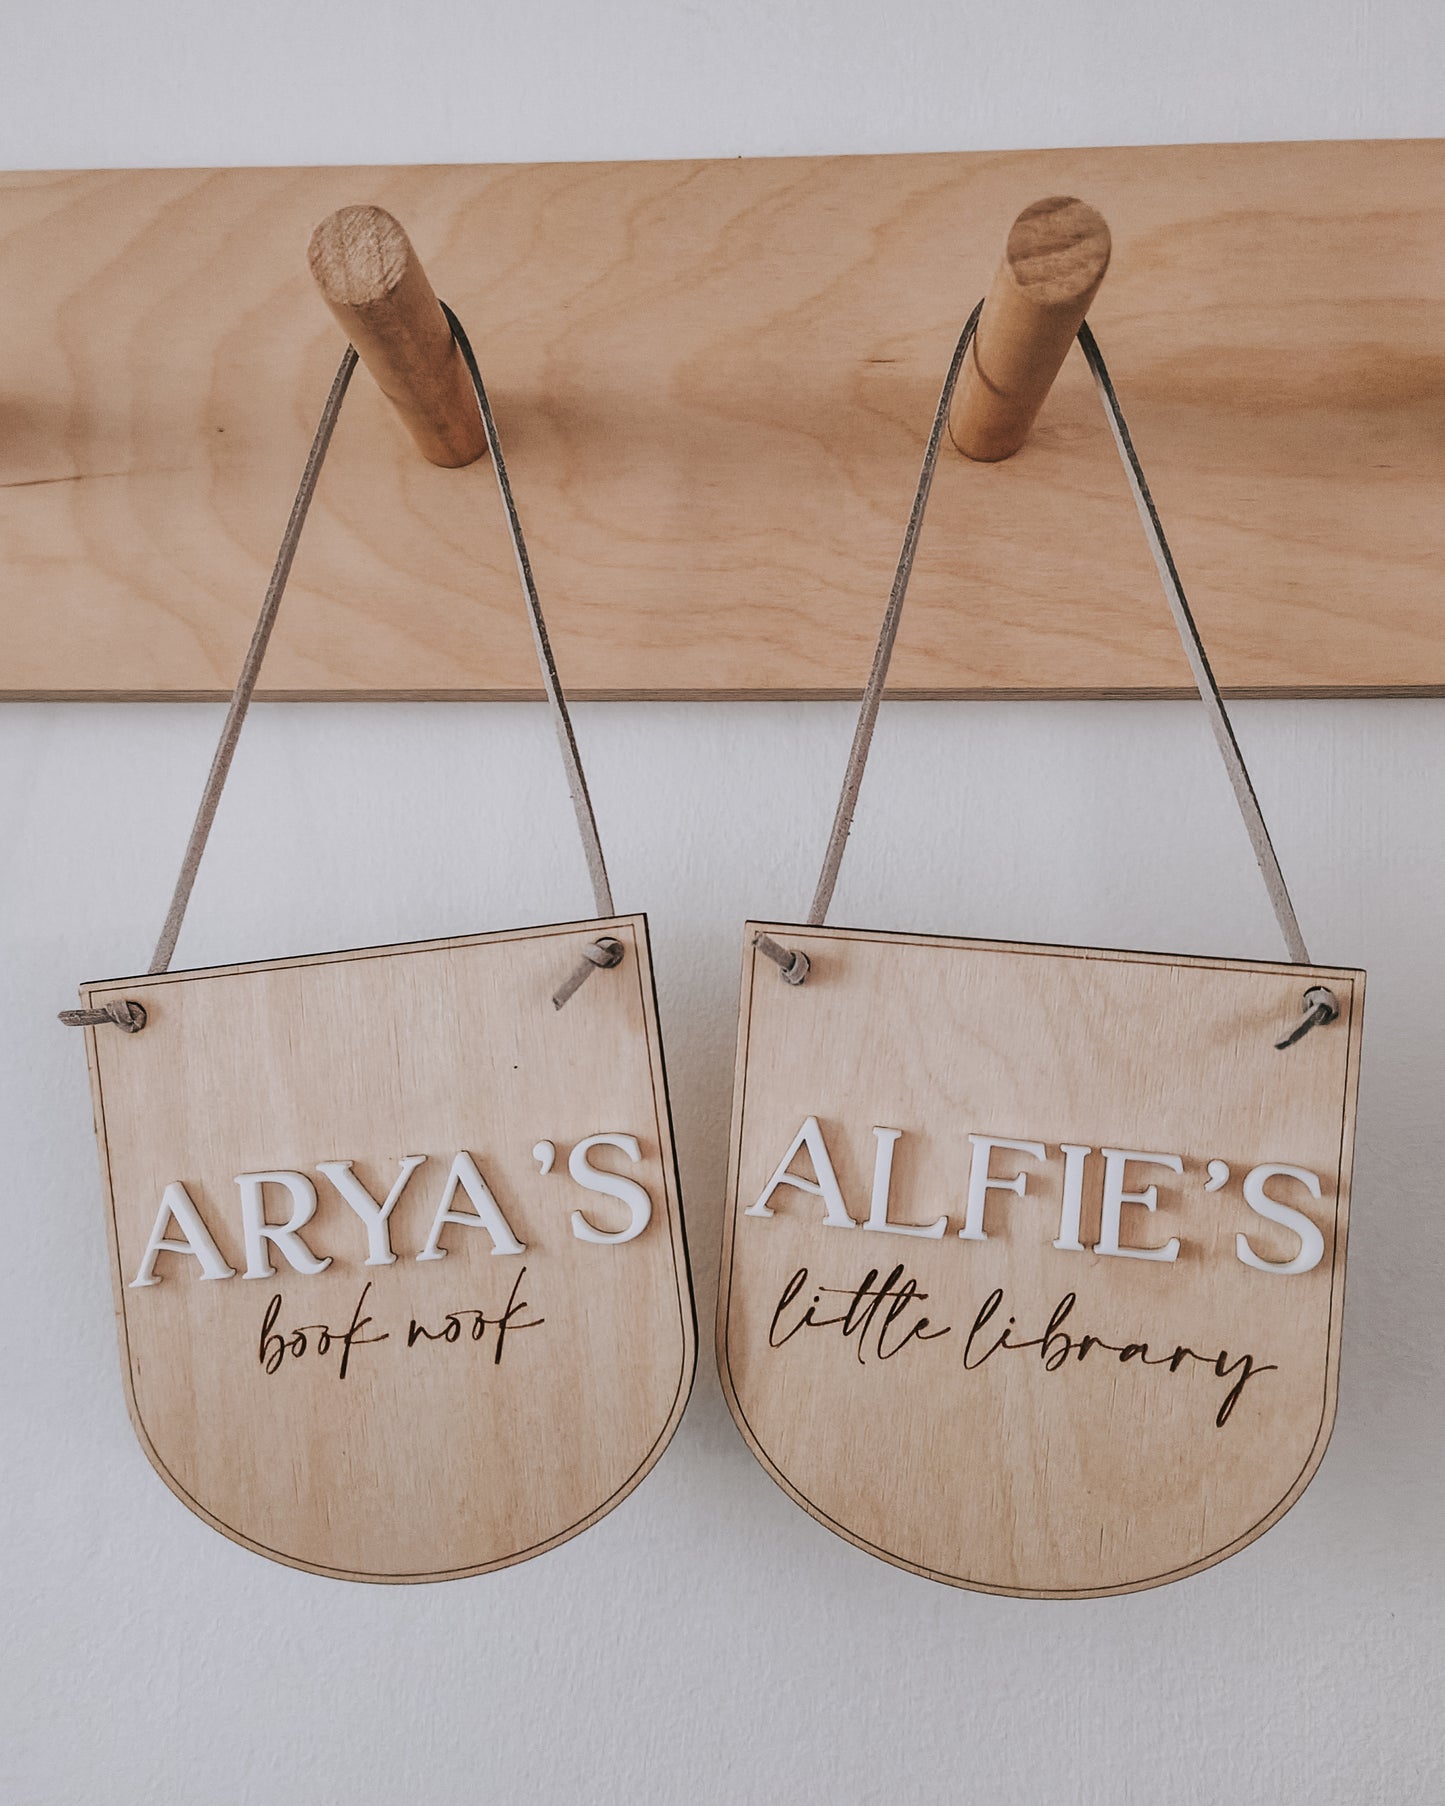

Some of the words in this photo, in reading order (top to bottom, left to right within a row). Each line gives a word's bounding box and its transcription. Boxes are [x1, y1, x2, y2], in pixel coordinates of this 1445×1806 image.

[129, 1132, 653, 1287] ARYA'S
[744, 1115, 1325, 1275] ALFIE'S
[259, 1281, 389, 1379] book
[407, 1266, 545, 1365] nook
[768, 1263, 951, 1366] little
[963, 1288, 1278, 1428] library
